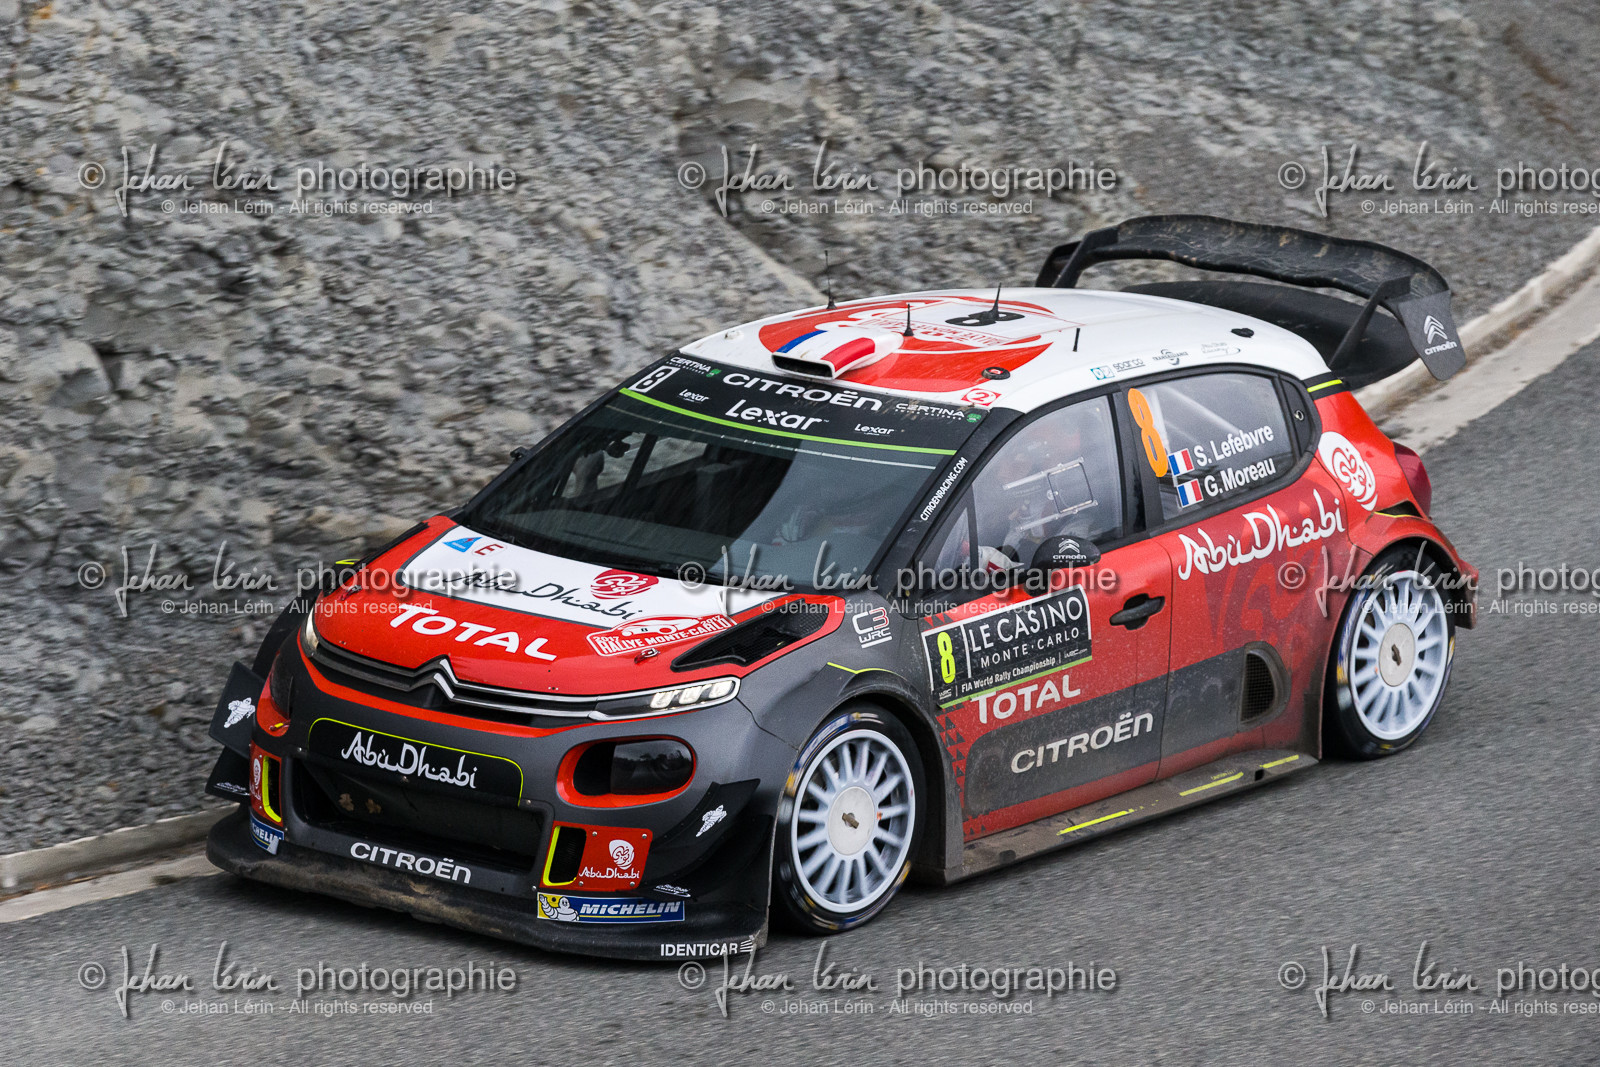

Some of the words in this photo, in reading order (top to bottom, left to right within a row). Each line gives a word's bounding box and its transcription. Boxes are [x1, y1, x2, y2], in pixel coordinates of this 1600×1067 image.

[1424, 341, 1457, 356] CITROËN
[670, 356, 711, 372] CERTINA
[679, 389, 709, 402] Lexar
[722, 373, 883, 411] CITROËN
[725, 399, 823, 430] Lexar
[896, 403, 965, 418] CERTINA
[854, 423, 894, 435] Lexar
[1128, 388, 1168, 478] 8
[1193, 446, 1212, 467] S.
[1210, 425, 1274, 461] Lefebvre
[920, 456, 968, 521] CITROENRACING.COM
[1204, 475, 1223, 497] G.
[1221, 457, 1276, 492] Moreau
[474, 543, 504, 556] E
[389, 602, 558, 662] TOTAL
[700, 615, 722, 627] 2017
[852, 606, 889, 635] C3
[858, 627, 891, 644] WRC
[967, 624, 994, 653] LE
[997, 596, 1083, 642] CASINO
[593, 635, 620, 645] 2017
[598, 636, 645, 655] RALLYE
[937, 631, 956, 684] 8
[961, 682, 973, 693] FIA
[973, 675, 994, 689] World
[994, 670, 1011, 683] Rally
[1012, 656, 1056, 677] Championship
[970, 674, 1081, 724] TOTAL
[1010, 711, 1153, 774] CITROËN
[350, 842, 472, 884] CITROËN
[580, 901, 681, 915] MICHELIN
[660, 943, 738, 957] IDENTICAR
